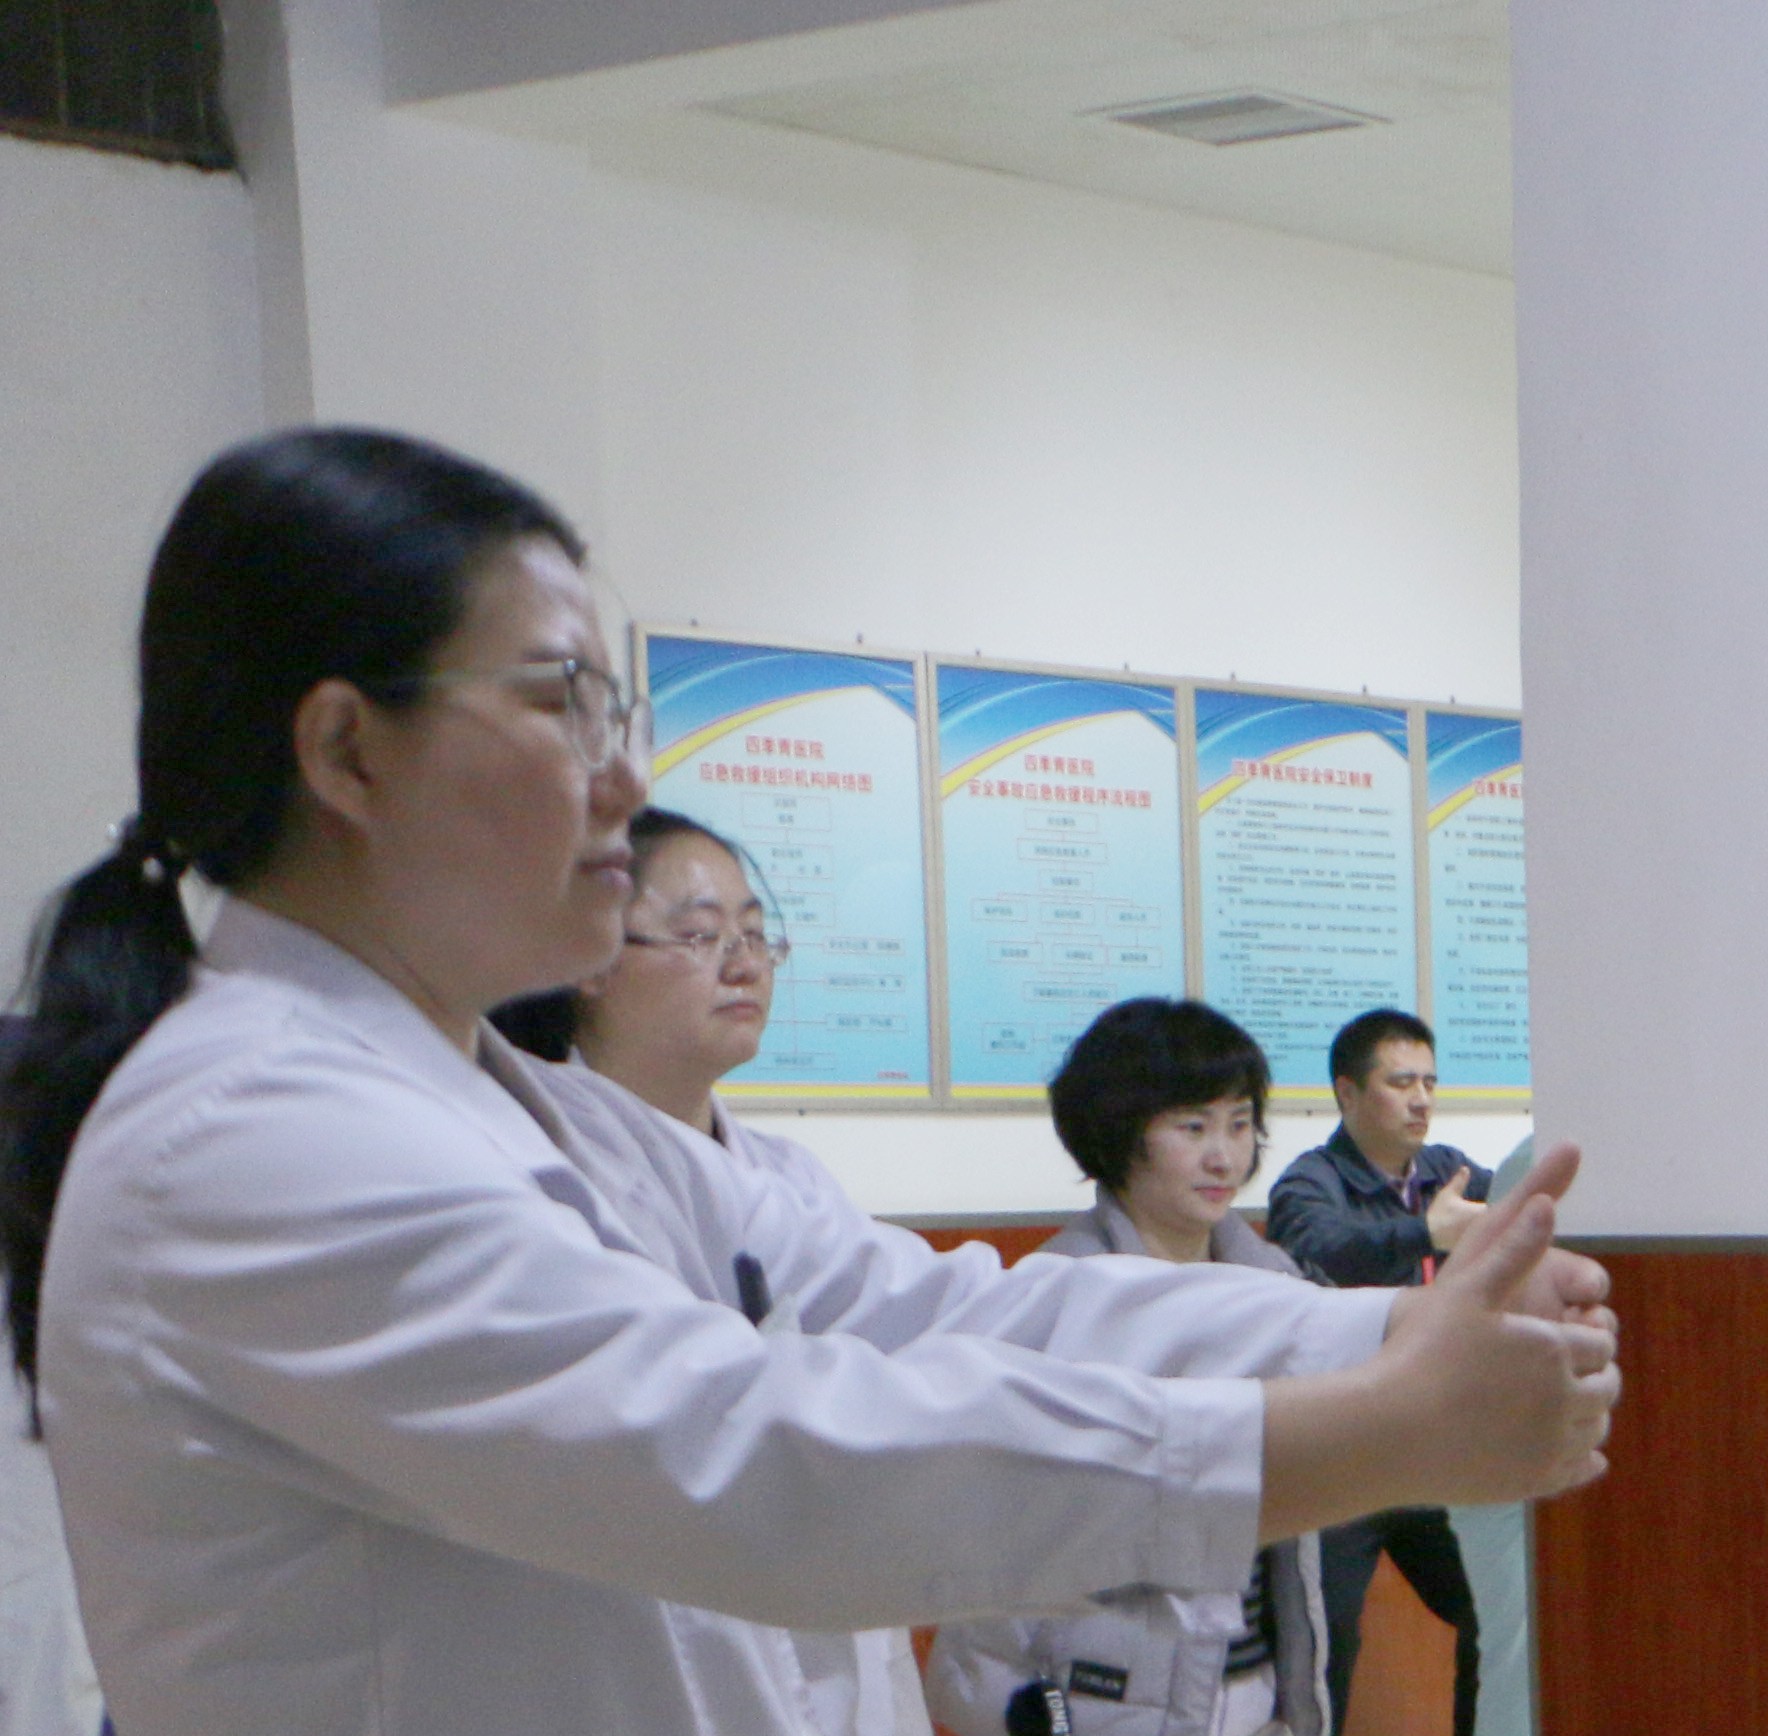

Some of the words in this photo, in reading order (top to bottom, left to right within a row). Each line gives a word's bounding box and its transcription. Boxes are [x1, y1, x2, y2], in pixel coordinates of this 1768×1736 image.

[746, 734, 825, 760] 四季青医院
[1025, 755, 1095, 776] 四季青医院
